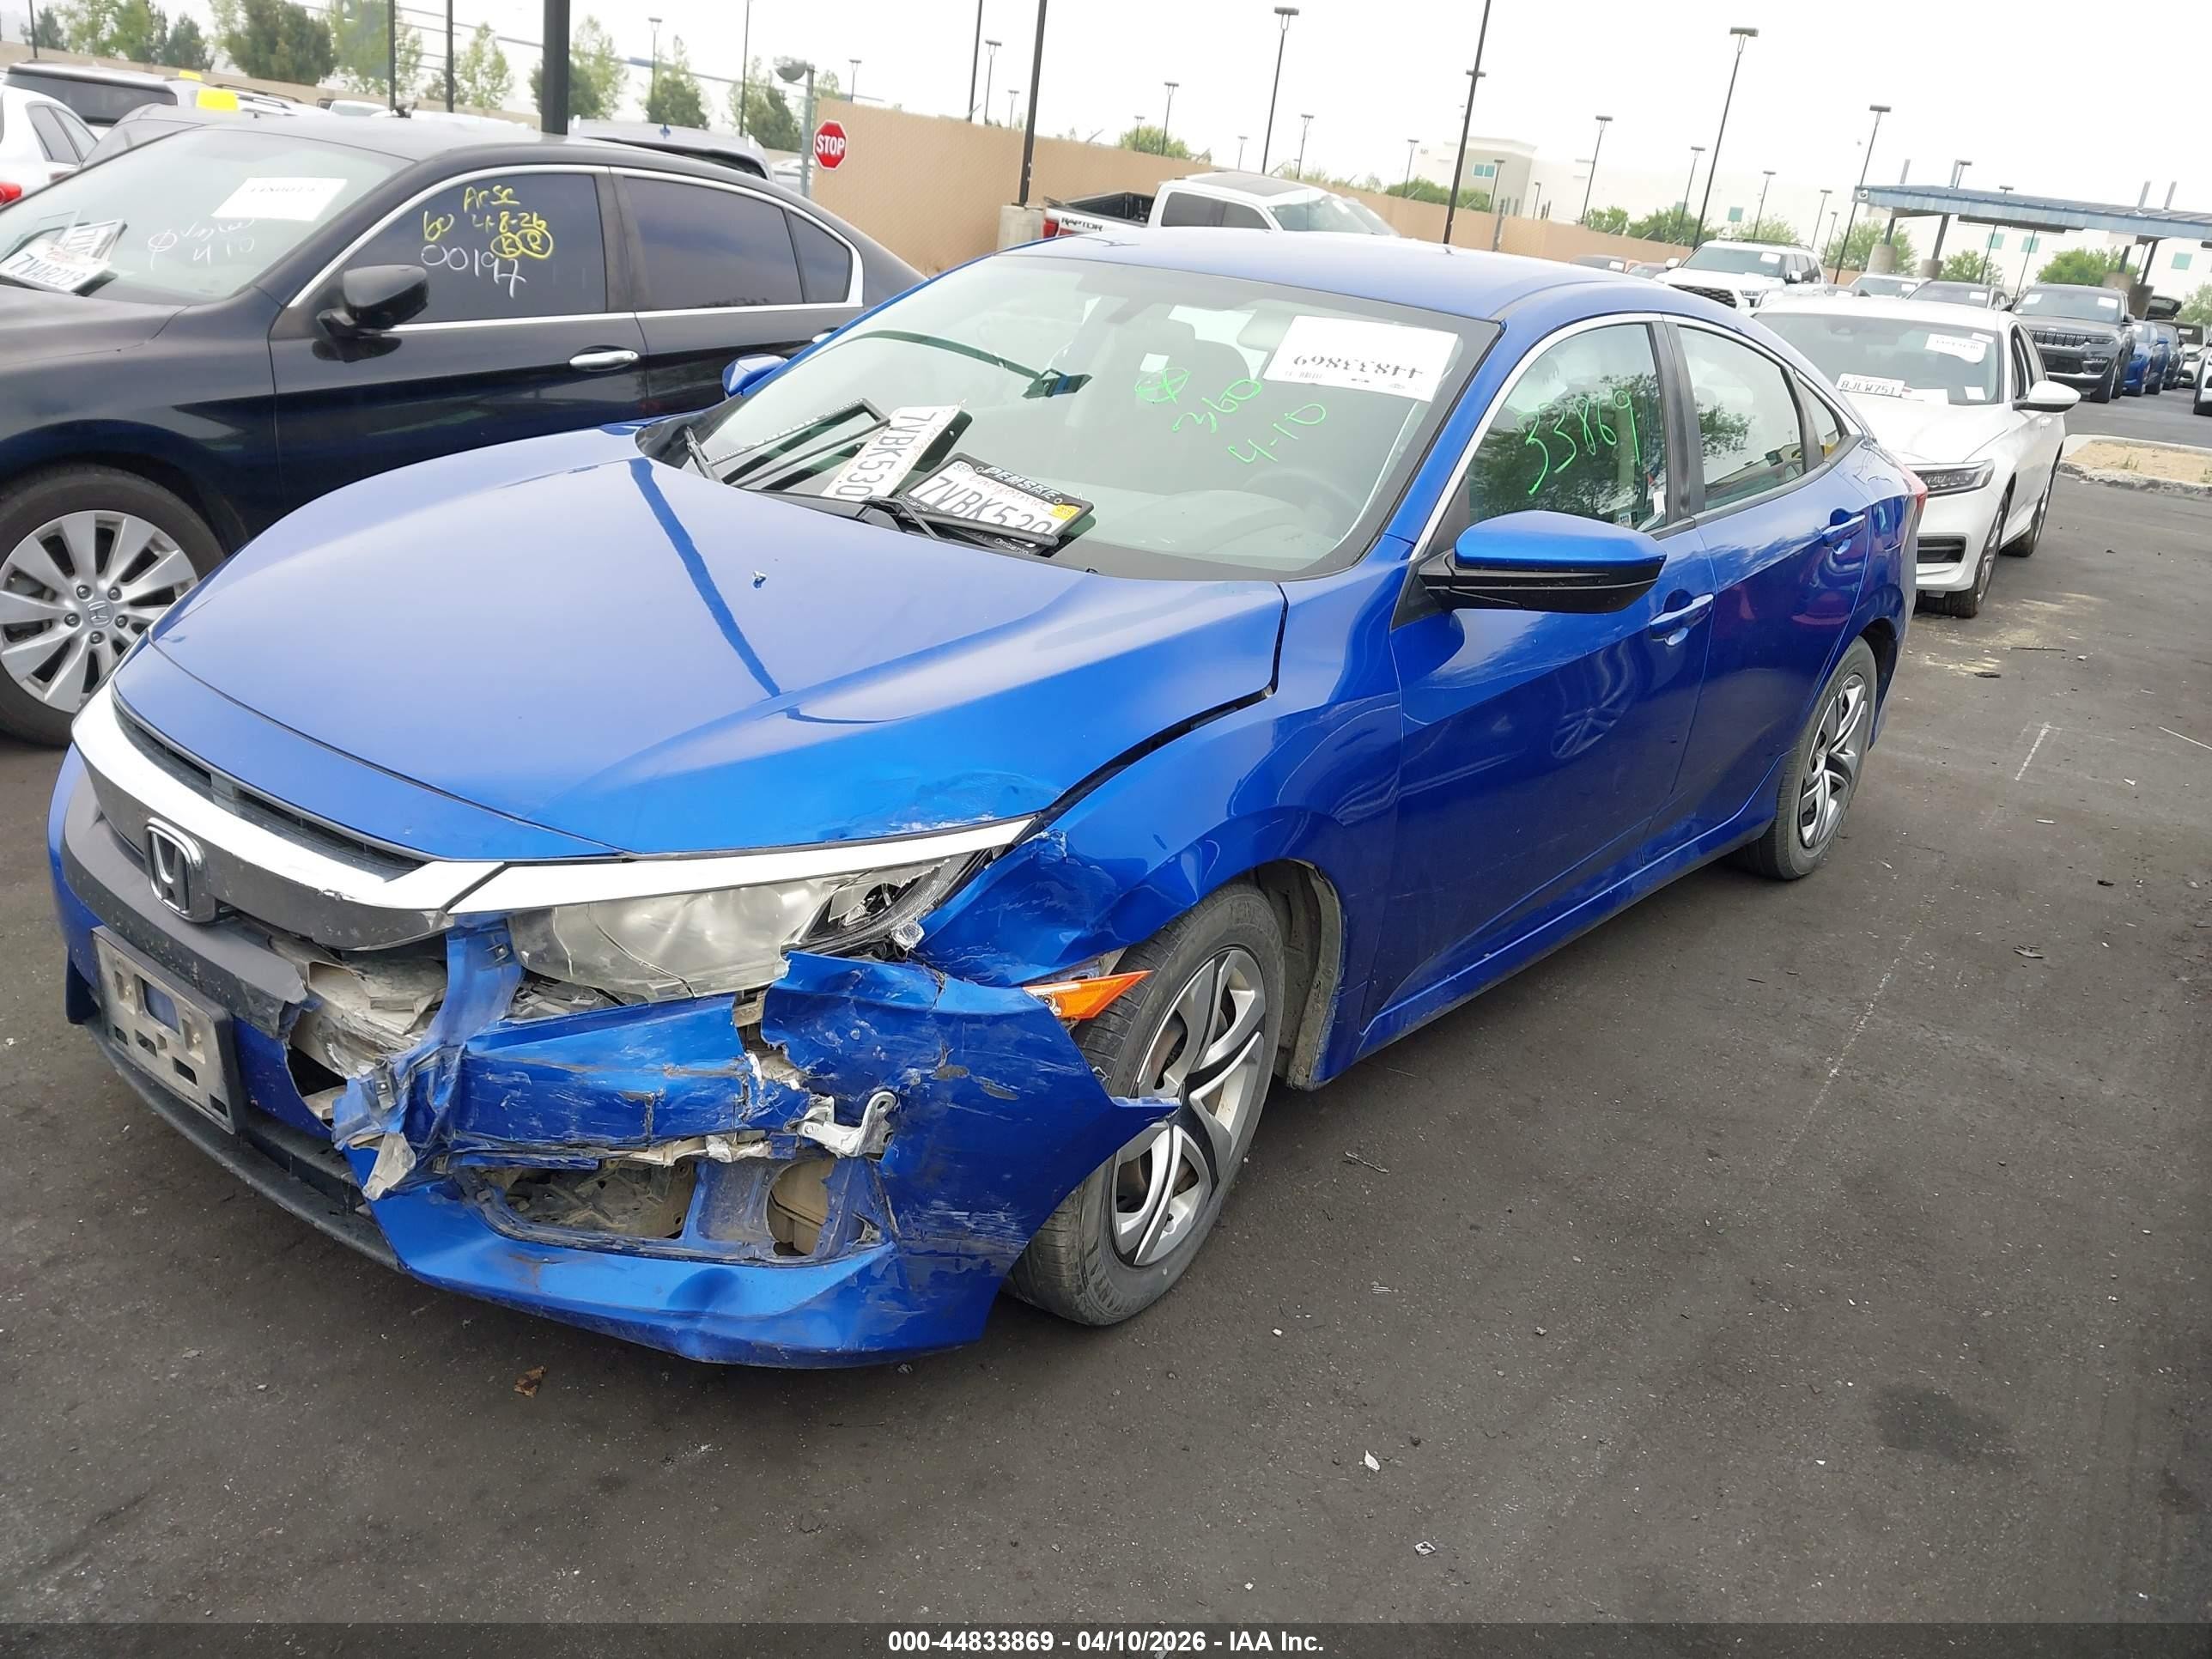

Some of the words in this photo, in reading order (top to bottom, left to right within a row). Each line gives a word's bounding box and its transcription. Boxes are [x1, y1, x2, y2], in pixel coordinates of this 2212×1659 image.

[816, 135, 845, 155] STOP
[1061, 216, 1104, 232] RAPTOR
[1841, 380, 1895, 395] 8JLW751
[1227, 404, 1327, 462] 4-10
[836, 412, 939, 496] 7VBK530
[983, 466, 1059, 500] PENSKE
[896, 494, 929, 513] Ontario
[994, 538, 1029, 555] Ontario
